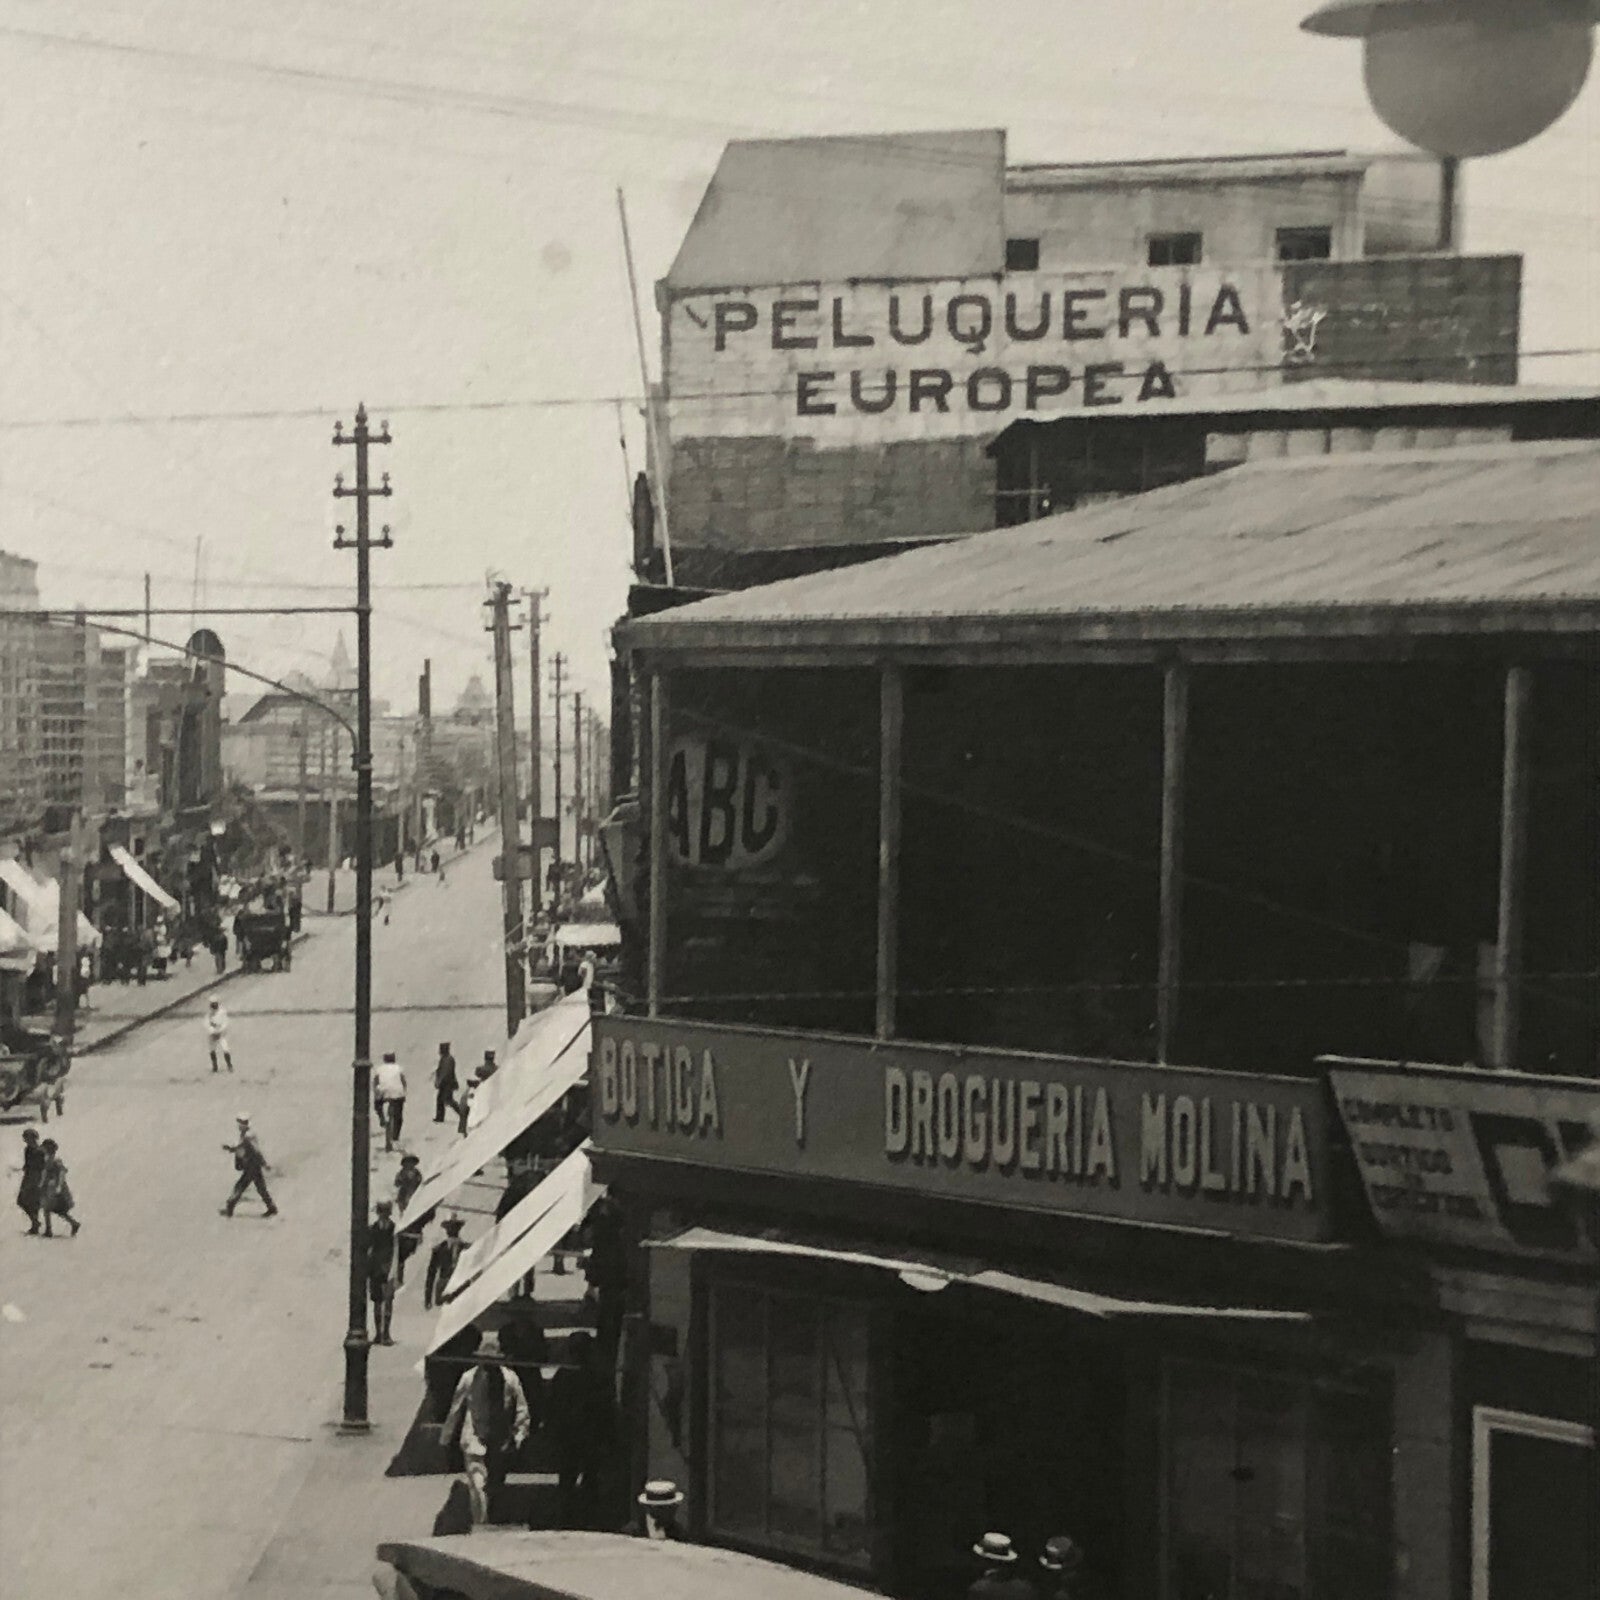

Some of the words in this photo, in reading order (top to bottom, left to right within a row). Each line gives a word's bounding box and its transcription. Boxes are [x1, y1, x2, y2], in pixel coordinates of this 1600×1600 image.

[714, 283, 1250, 353] PELUQUERIA
[797, 360, 1176, 416] EUROPEA
[667, 741, 781, 863] ABC
[602, 1037, 720, 1131] BOTICA
[788, 1058, 810, 1144] Y
[885, 1067, 1115, 1180] DROGUERIA
[1140, 1092, 1312, 1201] MOLINA
